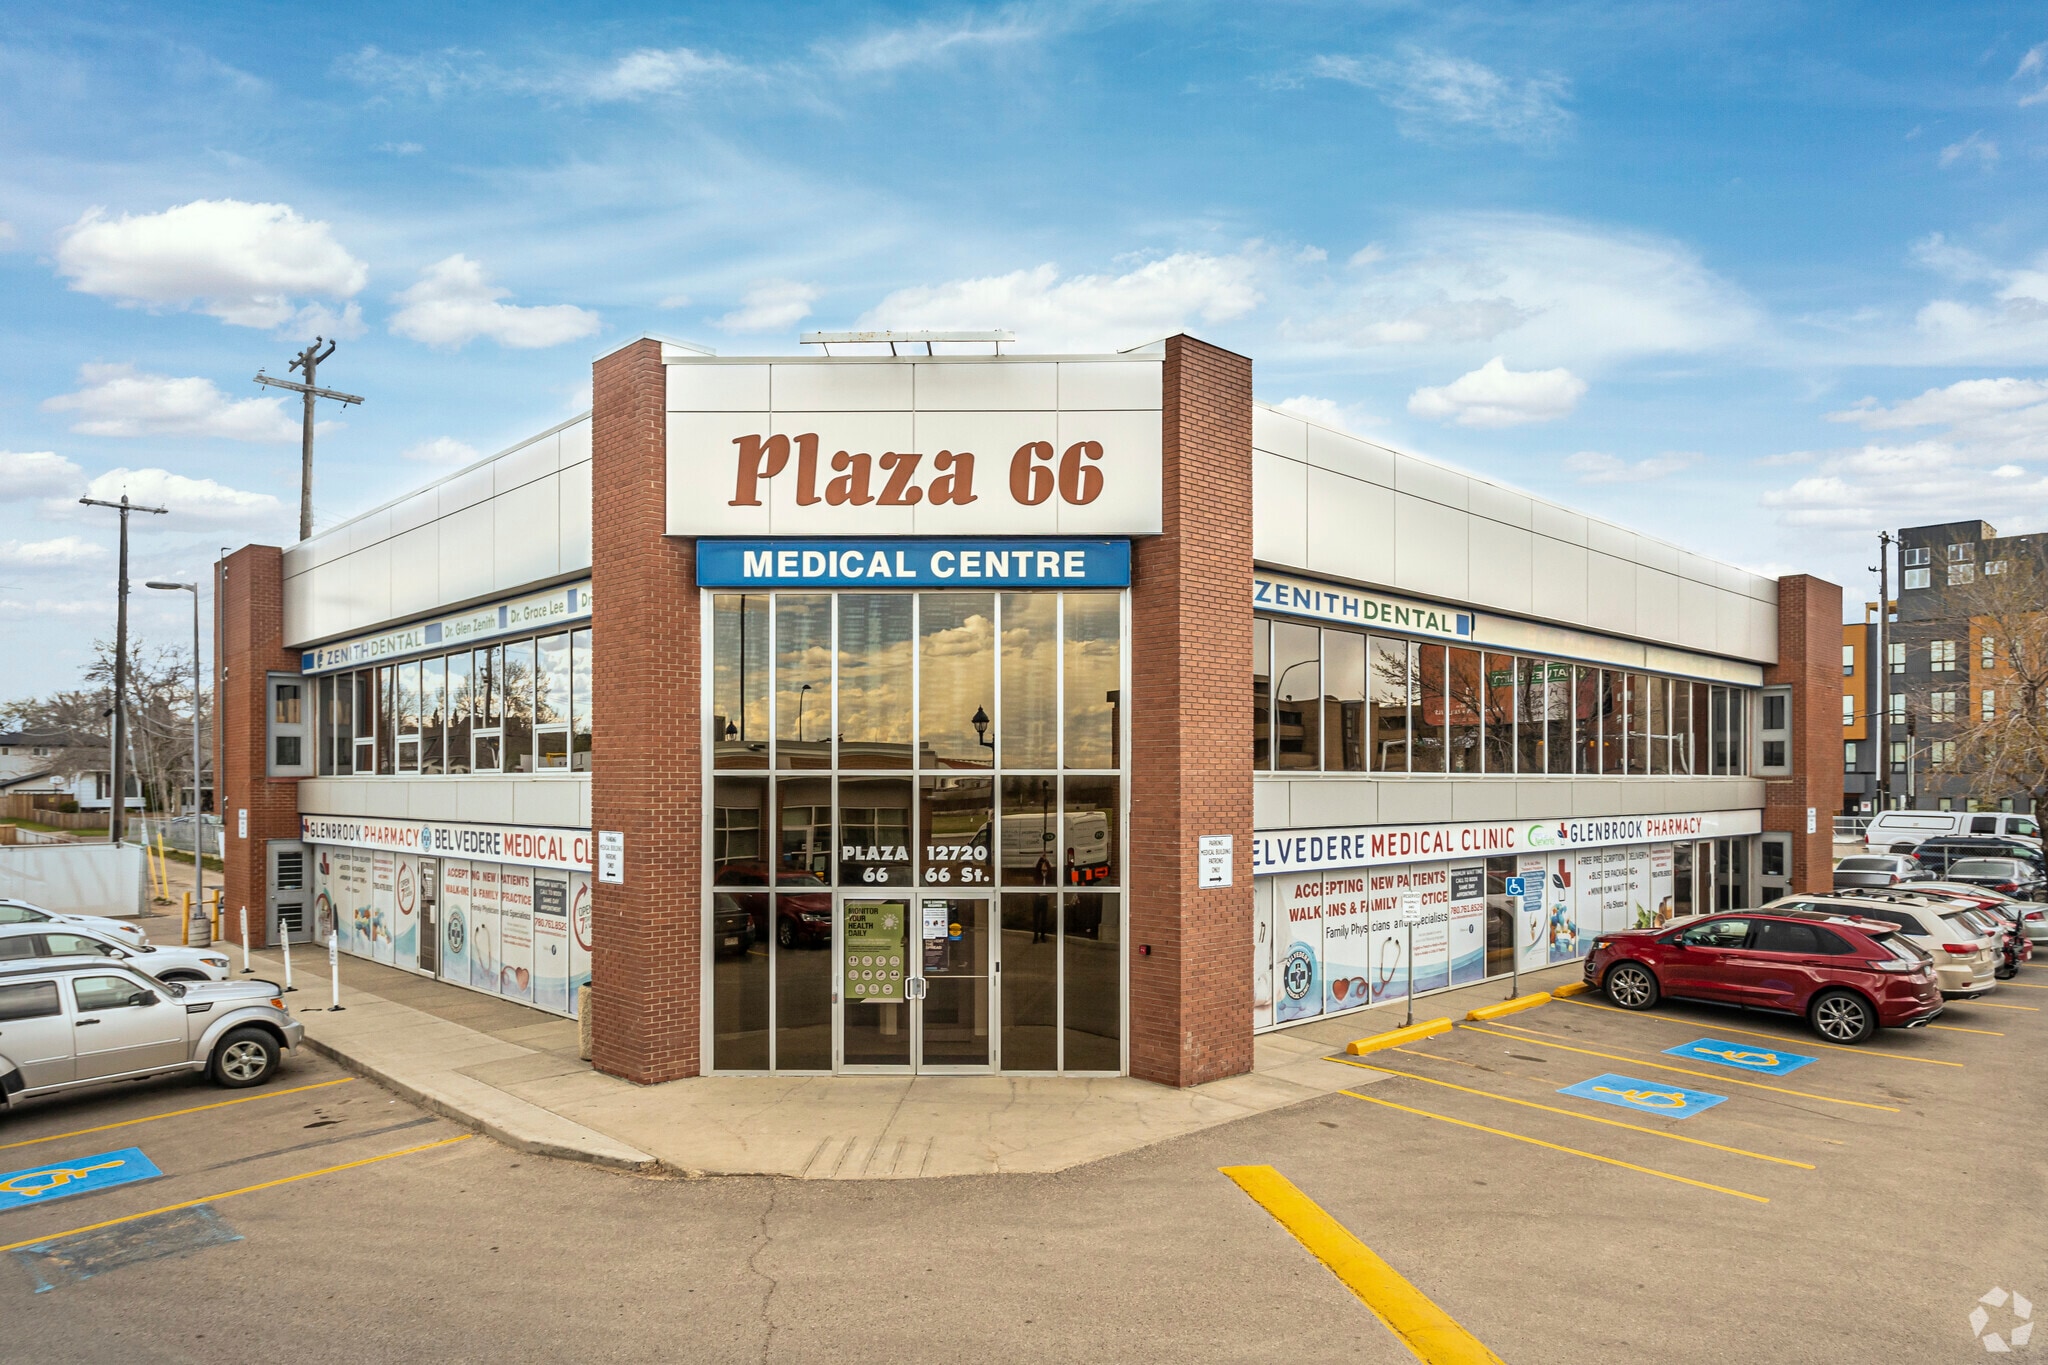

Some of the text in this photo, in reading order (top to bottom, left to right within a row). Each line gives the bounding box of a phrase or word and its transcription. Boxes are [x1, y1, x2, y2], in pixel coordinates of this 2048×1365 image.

[727, 432, 1105, 507] Plaza 66
[743, 550, 1086, 579] MEDICAL CENTRE
[511, 600, 564, 623] Dr. Grace Lee
[444, 615, 495, 638] Dr. Glen Zenith
[310, 821, 419, 848] GLENBROOK PHARMACY
[1570, 819, 1643, 843] GLENBROOK
[1647, 817, 1702, 837] PHARMACY
[434, 828, 592, 865] BELVEDERE MEDICAL CL
[842, 845, 909, 861] PLAZA
[926, 845, 988, 861] 12720
[1253, 834, 1365, 866] ELVEDERE
[1371, 830, 1454, 858] MEDICAL
[1461, 826, 1515, 851] CLINIC
[447, 867, 480, 881] ACCEPTNG
[483, 871, 496, 882] NEW
[862, 867, 889, 883] 66
[924, 867, 990, 883] 66 St.
[1294, 870, 1446, 899] ACCEPTING NEW PATIENTS
[479, 888, 498, 900] FAMILY
[501, 891, 532, 906] PRACTICE
[1289, 902, 1347, 922] WALK-INS
[1349, 901, 1357, 915] &
[1360, 896, 1397, 913] FAMILY
[1325, 924, 1349, 940] Family
[1351, 920, 1390, 937] Physcians
